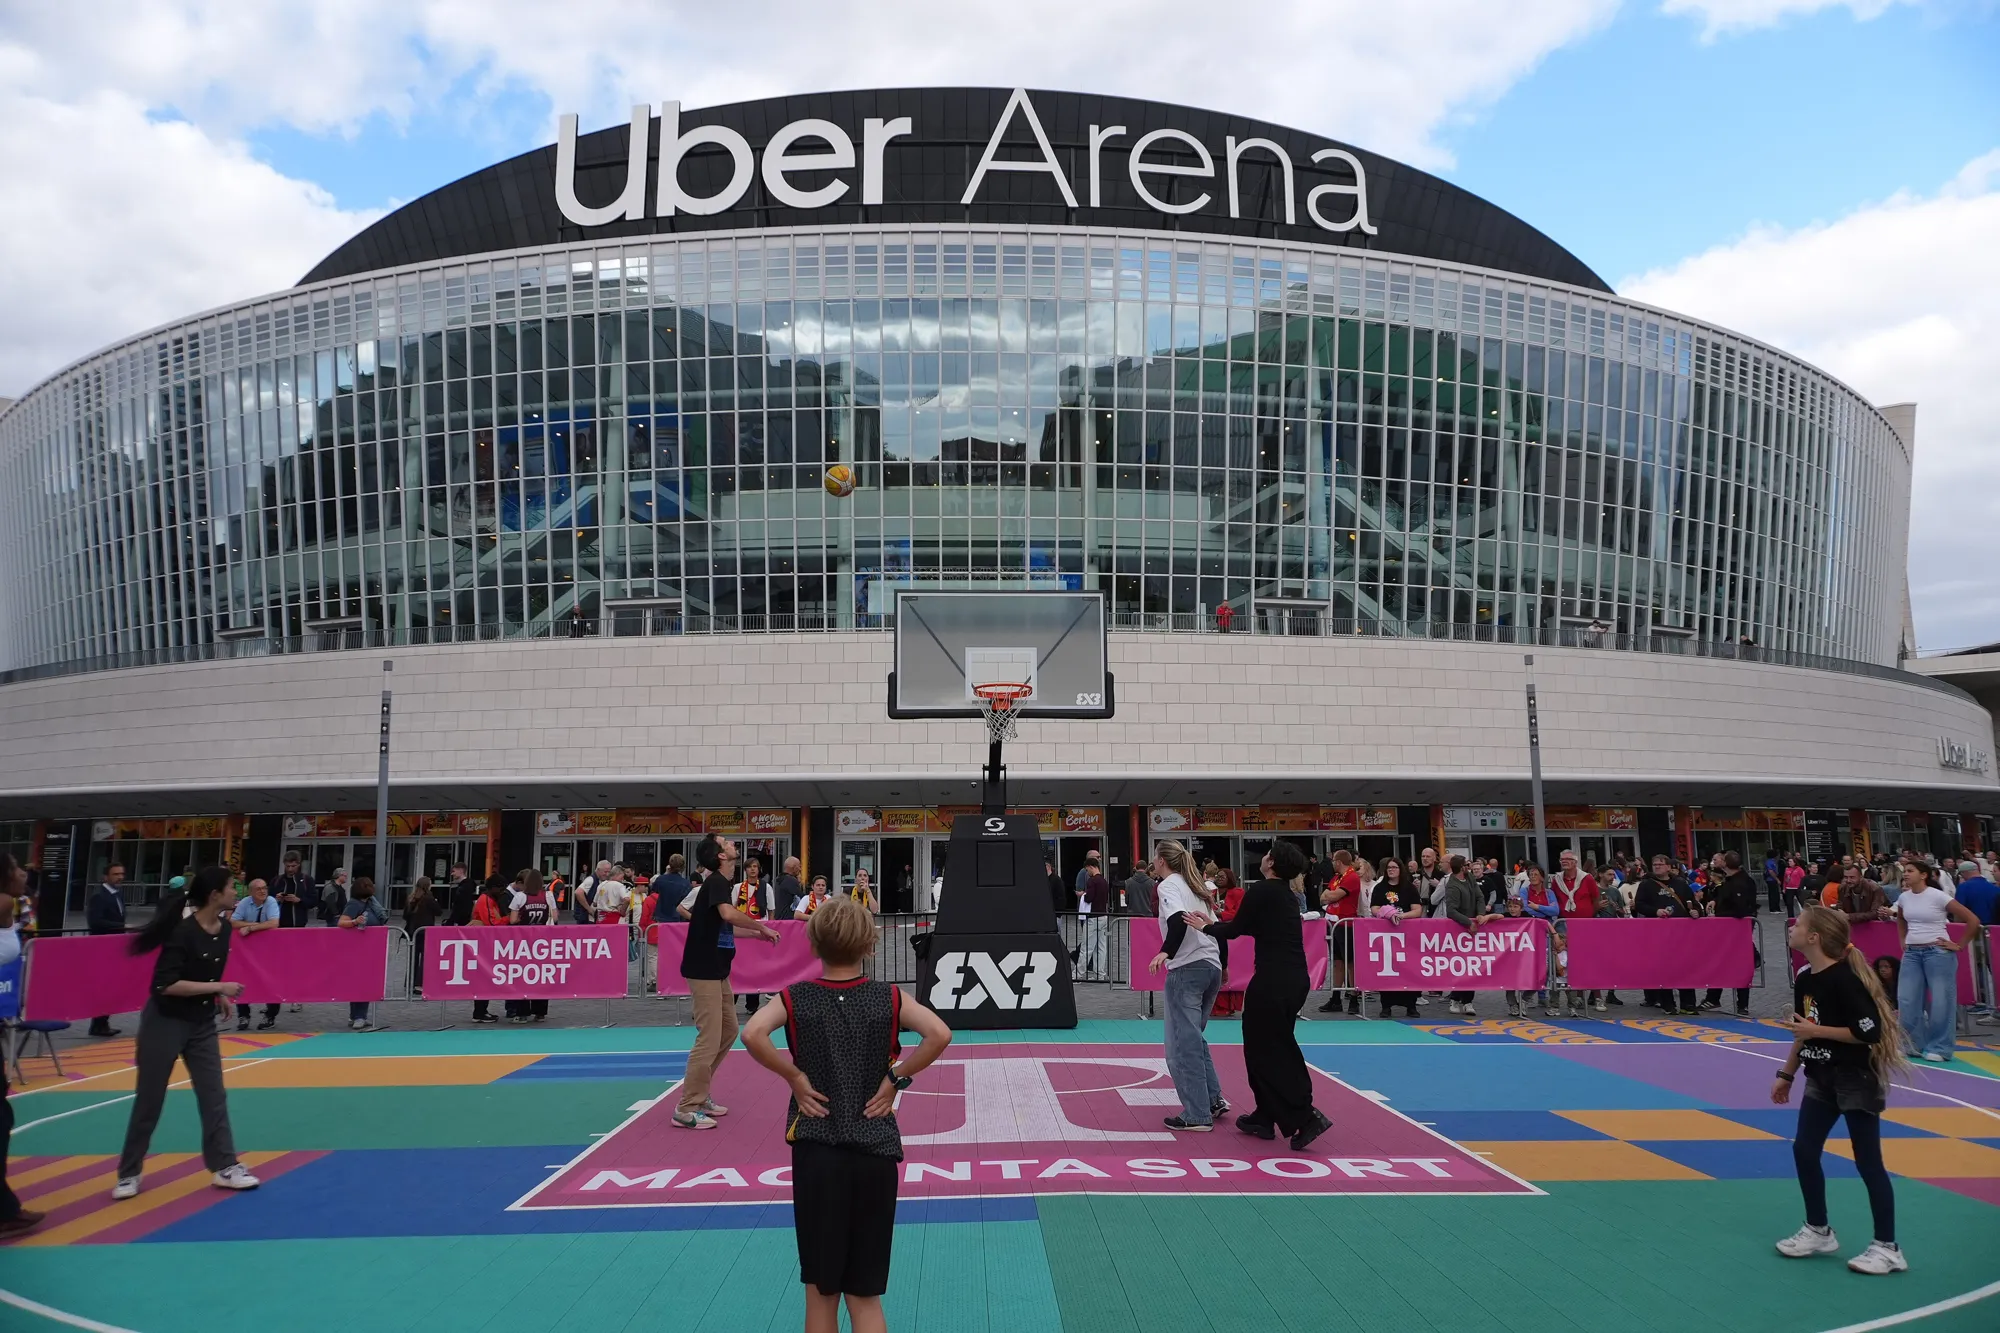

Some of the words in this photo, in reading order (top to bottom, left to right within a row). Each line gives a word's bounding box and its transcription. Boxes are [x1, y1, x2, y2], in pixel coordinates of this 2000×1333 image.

[555, 99, 911, 227] Uber
[960, 87, 1378, 236] Arena
[765, 818, 788, 828] Game!
[1066, 814, 1099, 827] Berlin
[1610, 814, 1633, 825] Berlin
[528, 910, 544, 924] 22
[493, 938, 612, 960] MAGENTA
[1420, 931, 1535, 953] MAGENTA
[439, 939, 478, 985] T
[1369, 932, 1406, 977] T
[492, 963, 571, 985] SPORT
[1420, 955, 1496, 977] SPORT
[1125, 1158, 1453, 1179] SPORT
